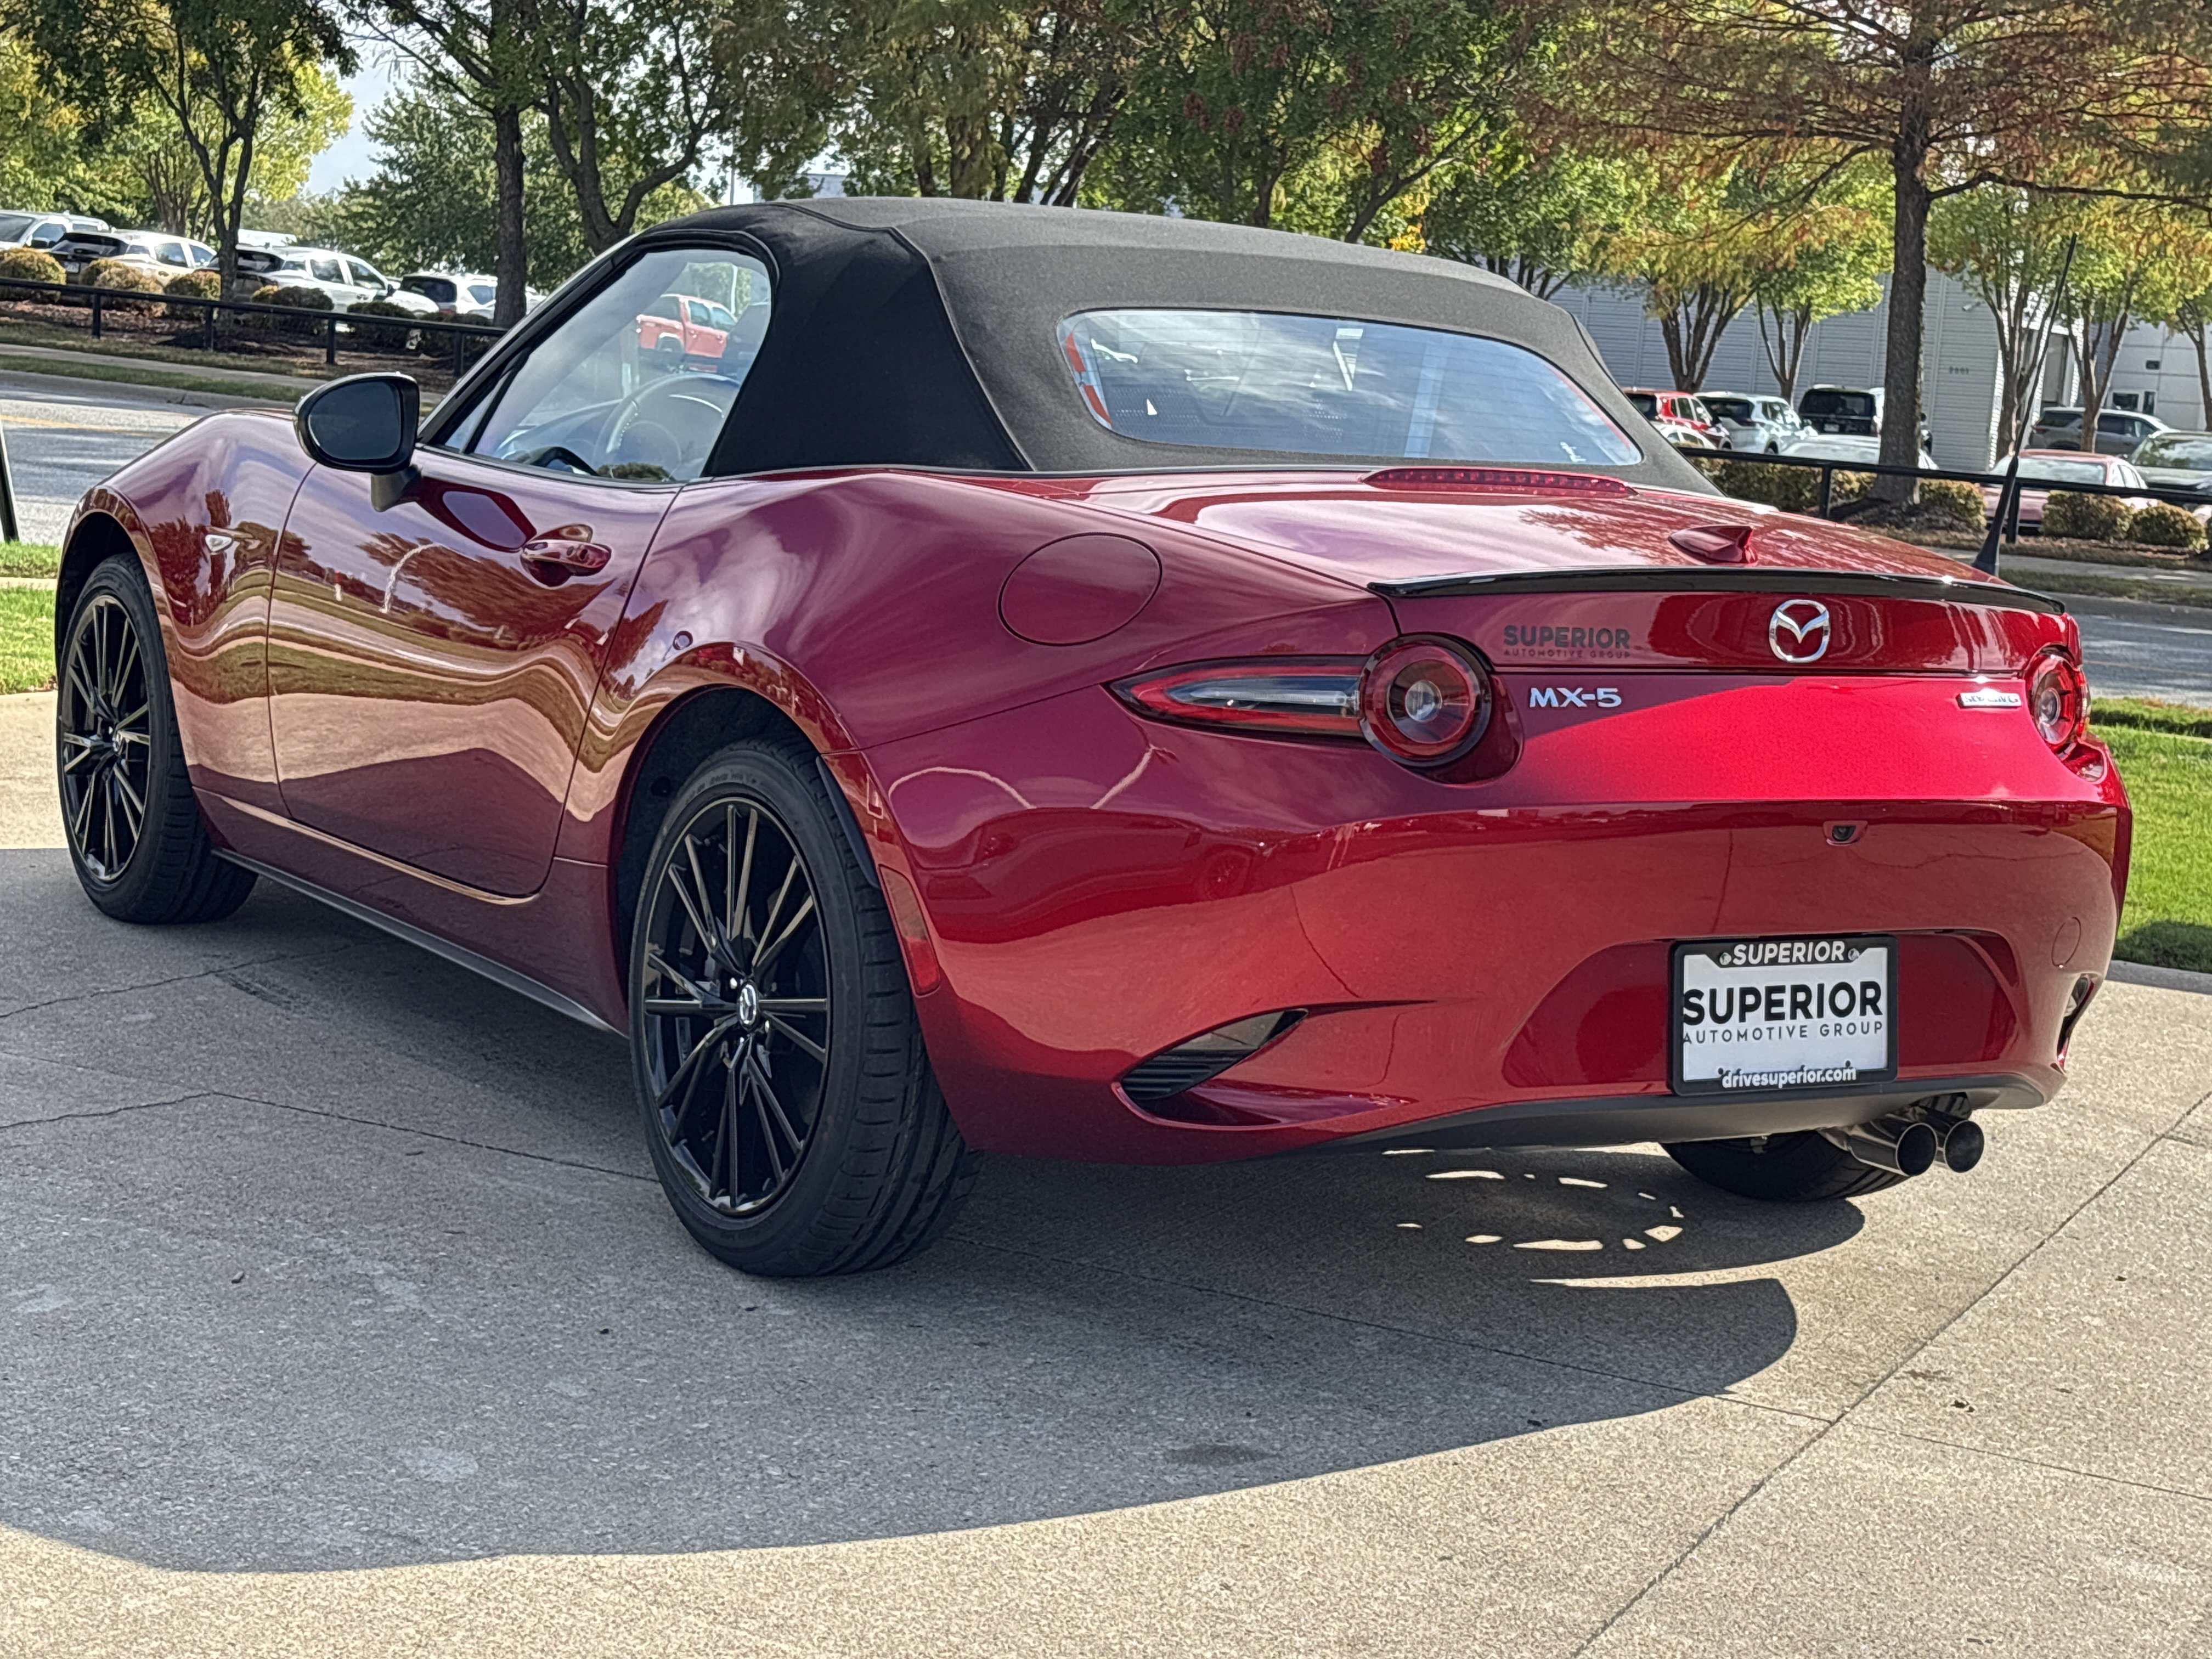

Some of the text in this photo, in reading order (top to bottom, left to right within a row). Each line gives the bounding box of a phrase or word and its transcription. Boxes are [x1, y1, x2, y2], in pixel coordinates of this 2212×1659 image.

[1503, 624, 1630, 650] SUPERIOR
[1503, 648, 1583, 658] AUTOMOTIVE
[1529, 687, 1622, 708] MX-5
[1732, 940, 1846, 965] SUPERIOR
[1683, 981, 1883, 1026] SUPERIOR
[1683, 1021, 1883, 1045] AUTOMOTIVE GROUP
[1722, 1067, 1857, 1089] drivesuperior.com
